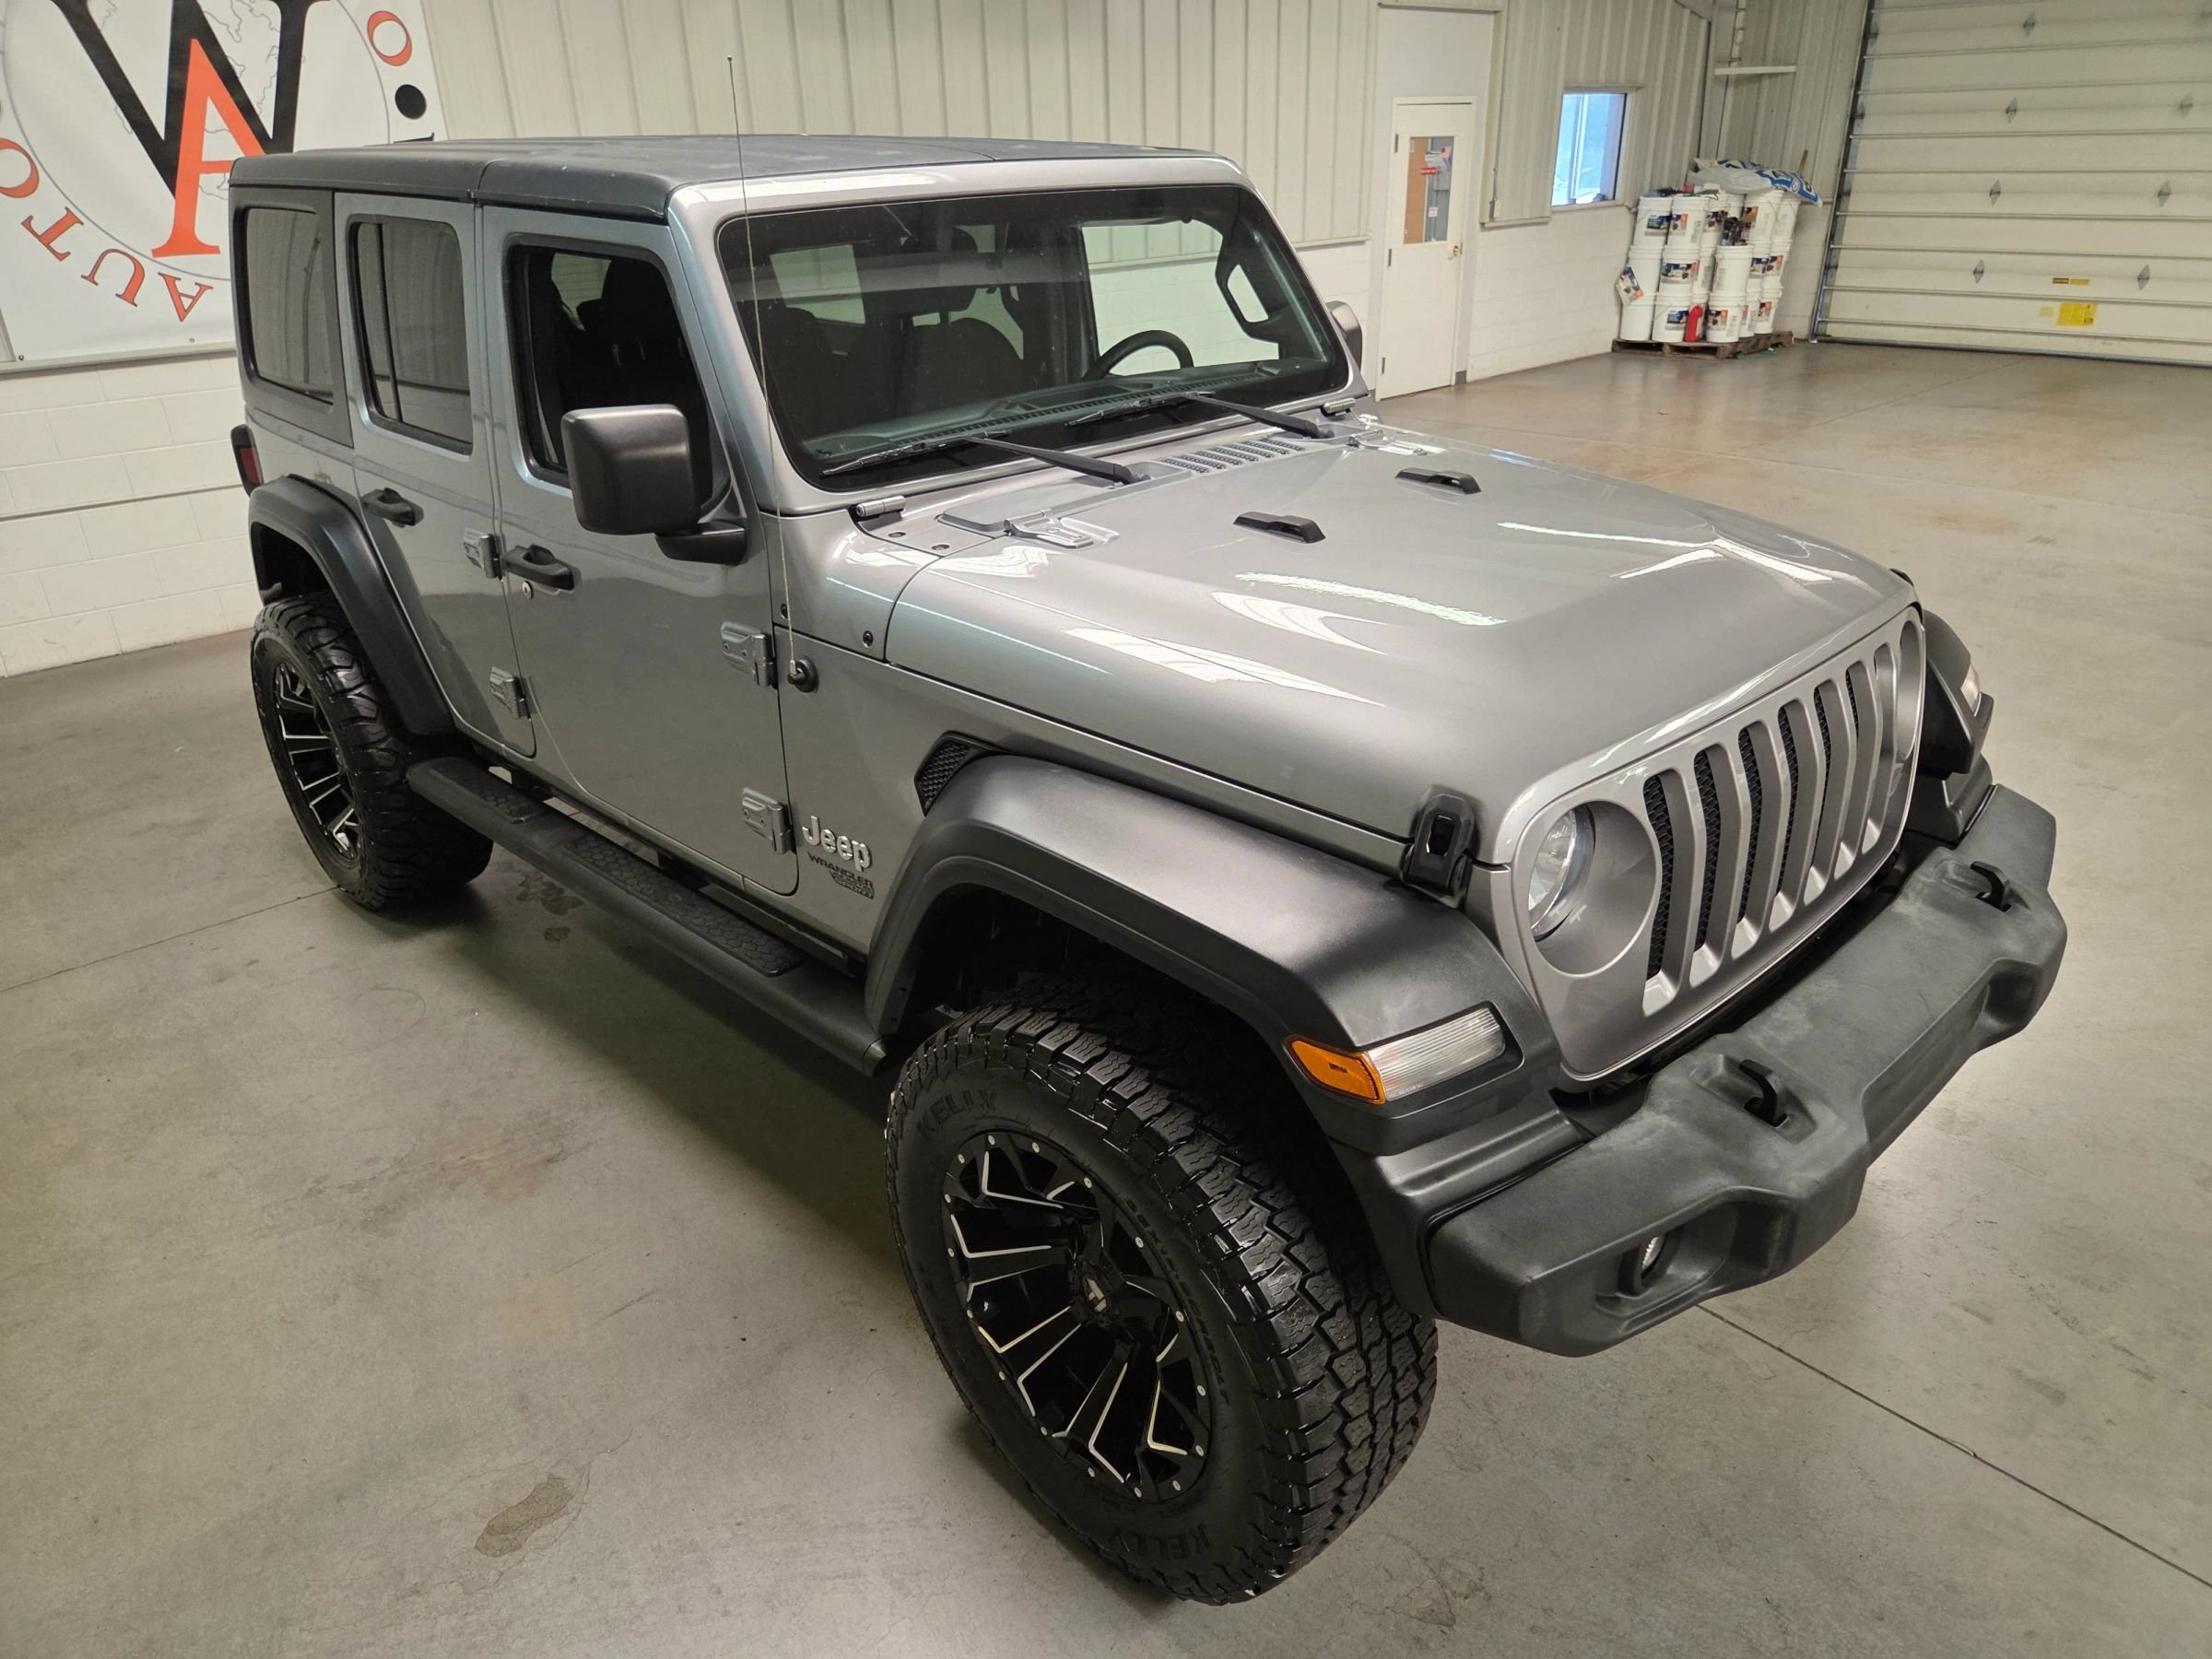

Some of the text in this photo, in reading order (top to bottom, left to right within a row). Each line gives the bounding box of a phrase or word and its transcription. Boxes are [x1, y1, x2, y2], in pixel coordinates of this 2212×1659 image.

[802, 815, 872, 872] Jeep
[807, 851, 873, 888] WRANGLER
[916, 1089, 998, 1140] KELLY
